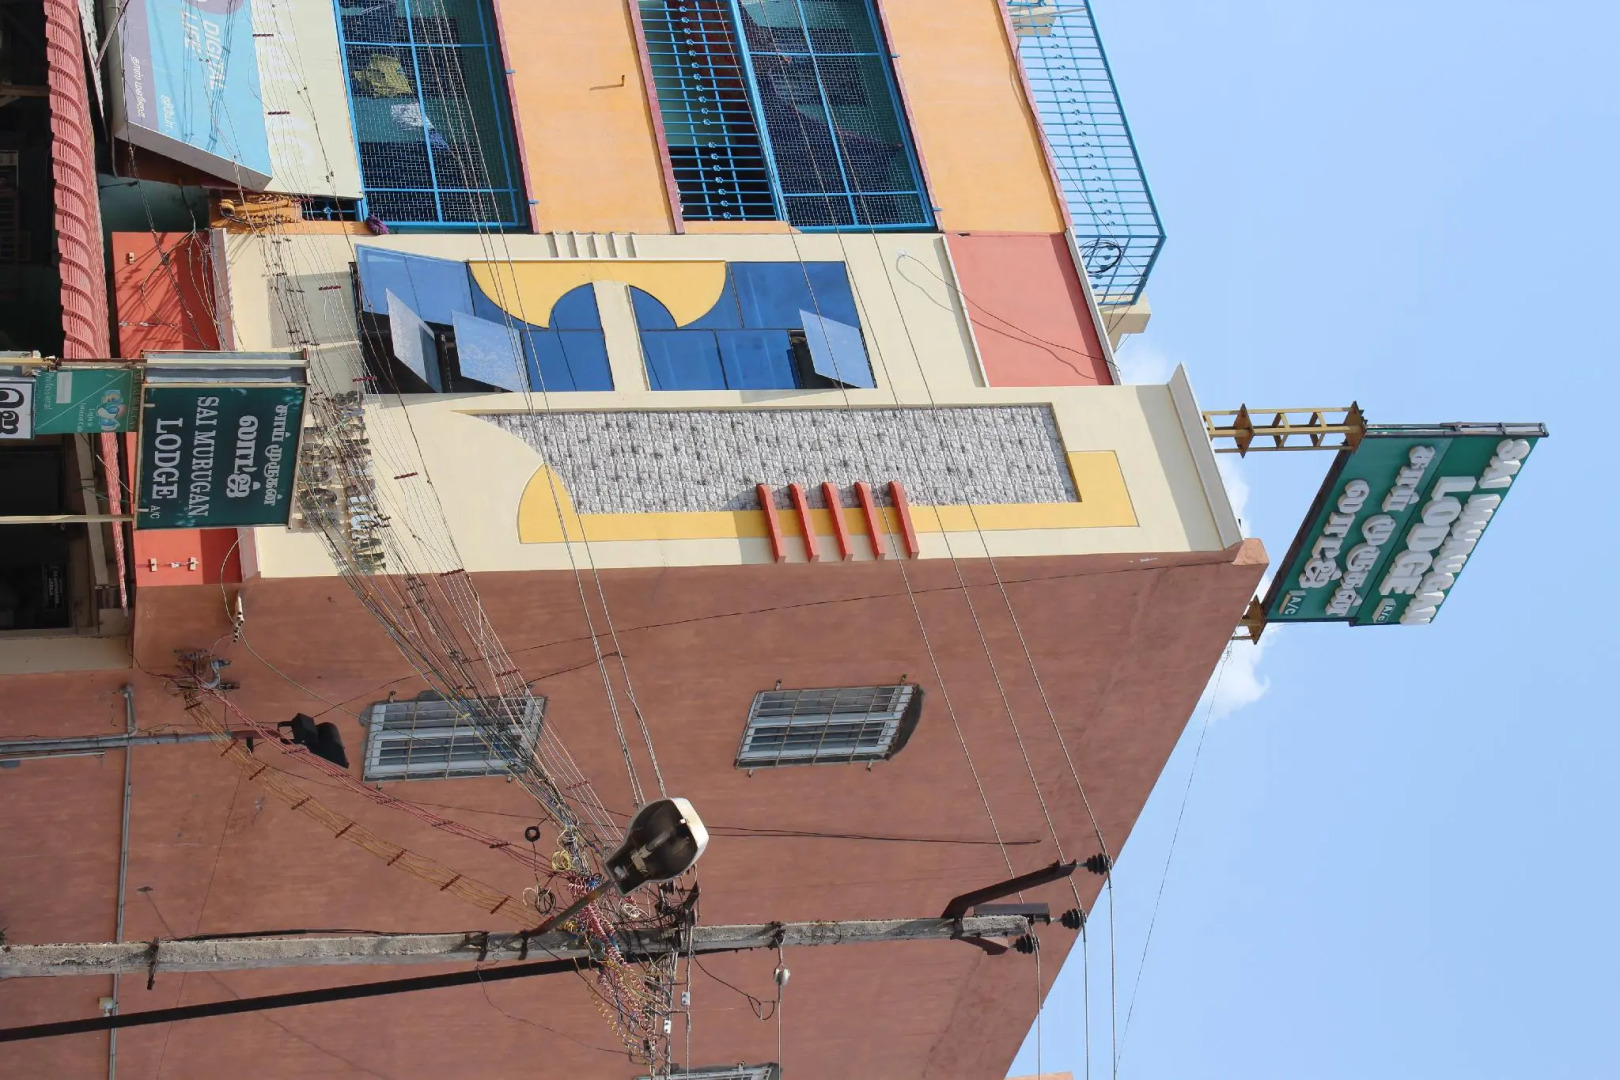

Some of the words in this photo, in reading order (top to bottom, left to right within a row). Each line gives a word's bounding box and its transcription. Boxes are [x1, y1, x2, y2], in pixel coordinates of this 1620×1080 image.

[180, 10, 203, 54] LIFE
[202, 20, 227, 91] DIGITAL
[44, 372, 55, 410] Professional
[195, 396, 220, 426] SAI
[271, 404, 291, 442] சாய்
[152, 418, 183, 500] LODGE
[188, 430, 218, 516] MURUGAN
[226, 415, 261, 499] லாட்ஜ்
[264, 444, 283, 506] முருகன்
[1381, 445, 1437, 512] சாய்
[1478, 438, 1531, 490] SAI
[149, 505, 161, 519] A/C
[1298, 480, 1370, 589] லாட்ஜ்
[1378, 476, 1477, 596] LODGE
[1324, 515, 1397, 617] முருகன்
[1399, 493, 1502, 626] MURUGAN
